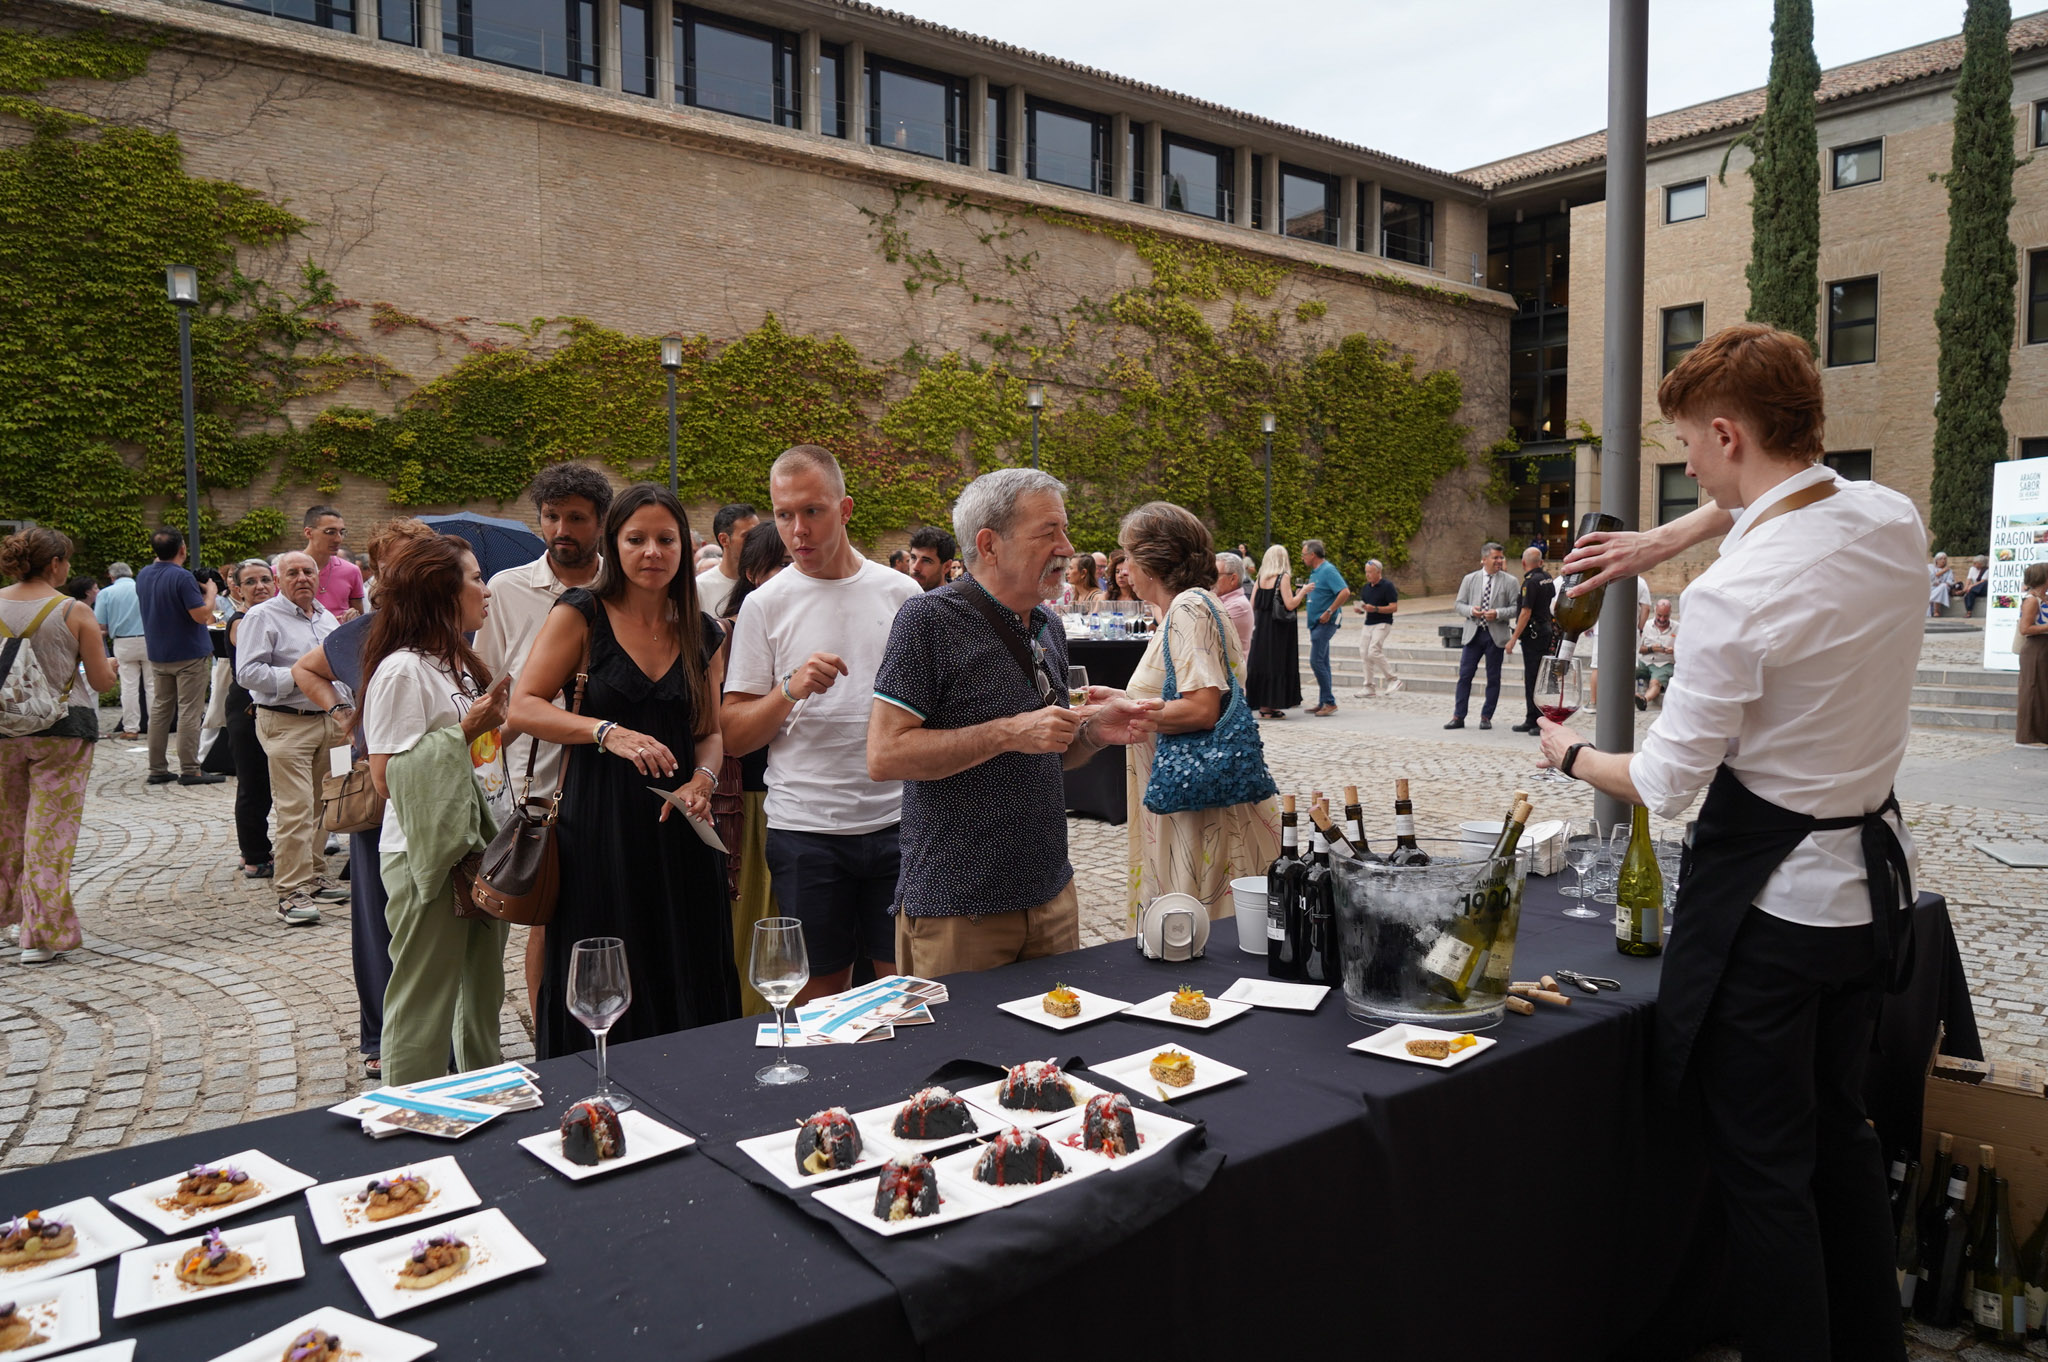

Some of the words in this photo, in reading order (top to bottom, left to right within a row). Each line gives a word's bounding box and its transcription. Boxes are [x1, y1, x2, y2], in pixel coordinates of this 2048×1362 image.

[2019, 480, 2041, 491] SABOR
[1995, 515, 2007, 529] EN
[2017, 546, 2035, 561] LOS
[1992, 579, 2021, 594] SABEN
[1460, 886, 1511, 916] 1900
